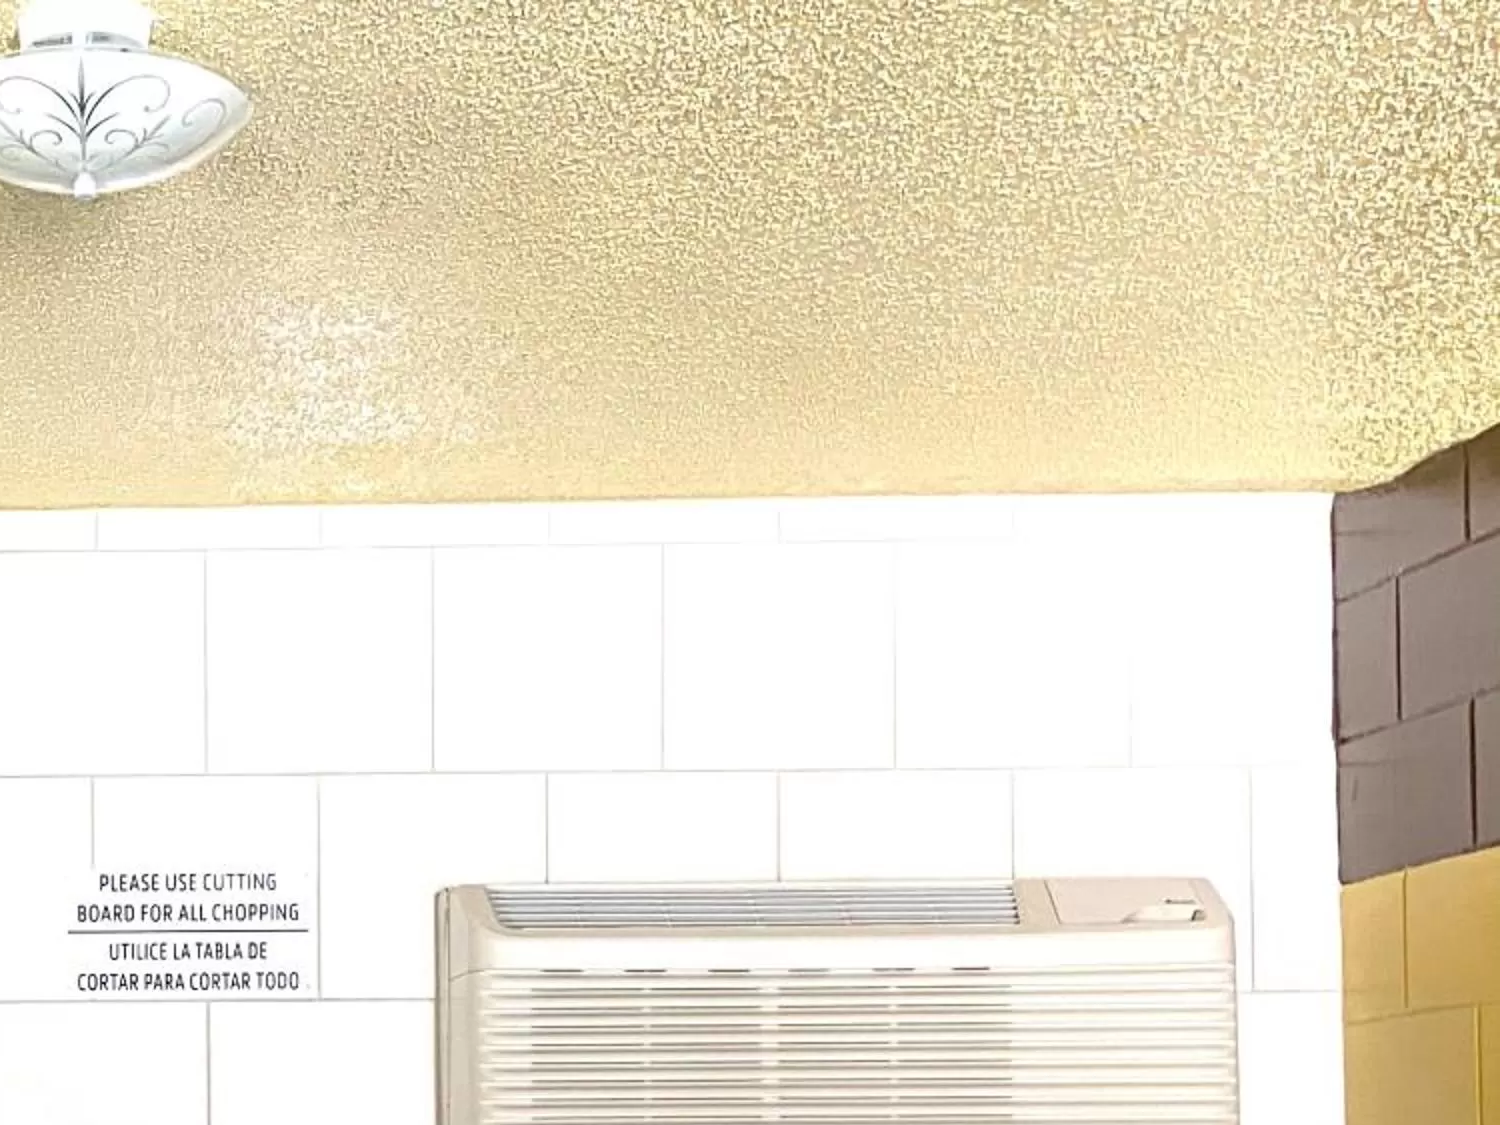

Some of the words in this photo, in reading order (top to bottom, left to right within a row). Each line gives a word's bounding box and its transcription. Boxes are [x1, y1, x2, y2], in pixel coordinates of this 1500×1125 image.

[99, 873, 160, 892] PLEASE
[165, 873, 197, 892] USE
[203, 873, 277, 891] CUTTING
[77, 904, 135, 922] BOARD
[141, 904, 173, 922] FOR
[178, 903, 207, 922] ALL
[212, 903, 299, 921] CHOPPING
[109, 943, 167, 960] UTILICE
[173, 943, 190, 960] LA
[196, 942, 243, 960] TABLA
[248, 941, 268, 960] DE
[77, 973, 139, 991] CORTAR
[144, 973, 184, 991] PARA
[189, 972, 250, 991] CORTAR
[256, 971, 300, 990] TODO
